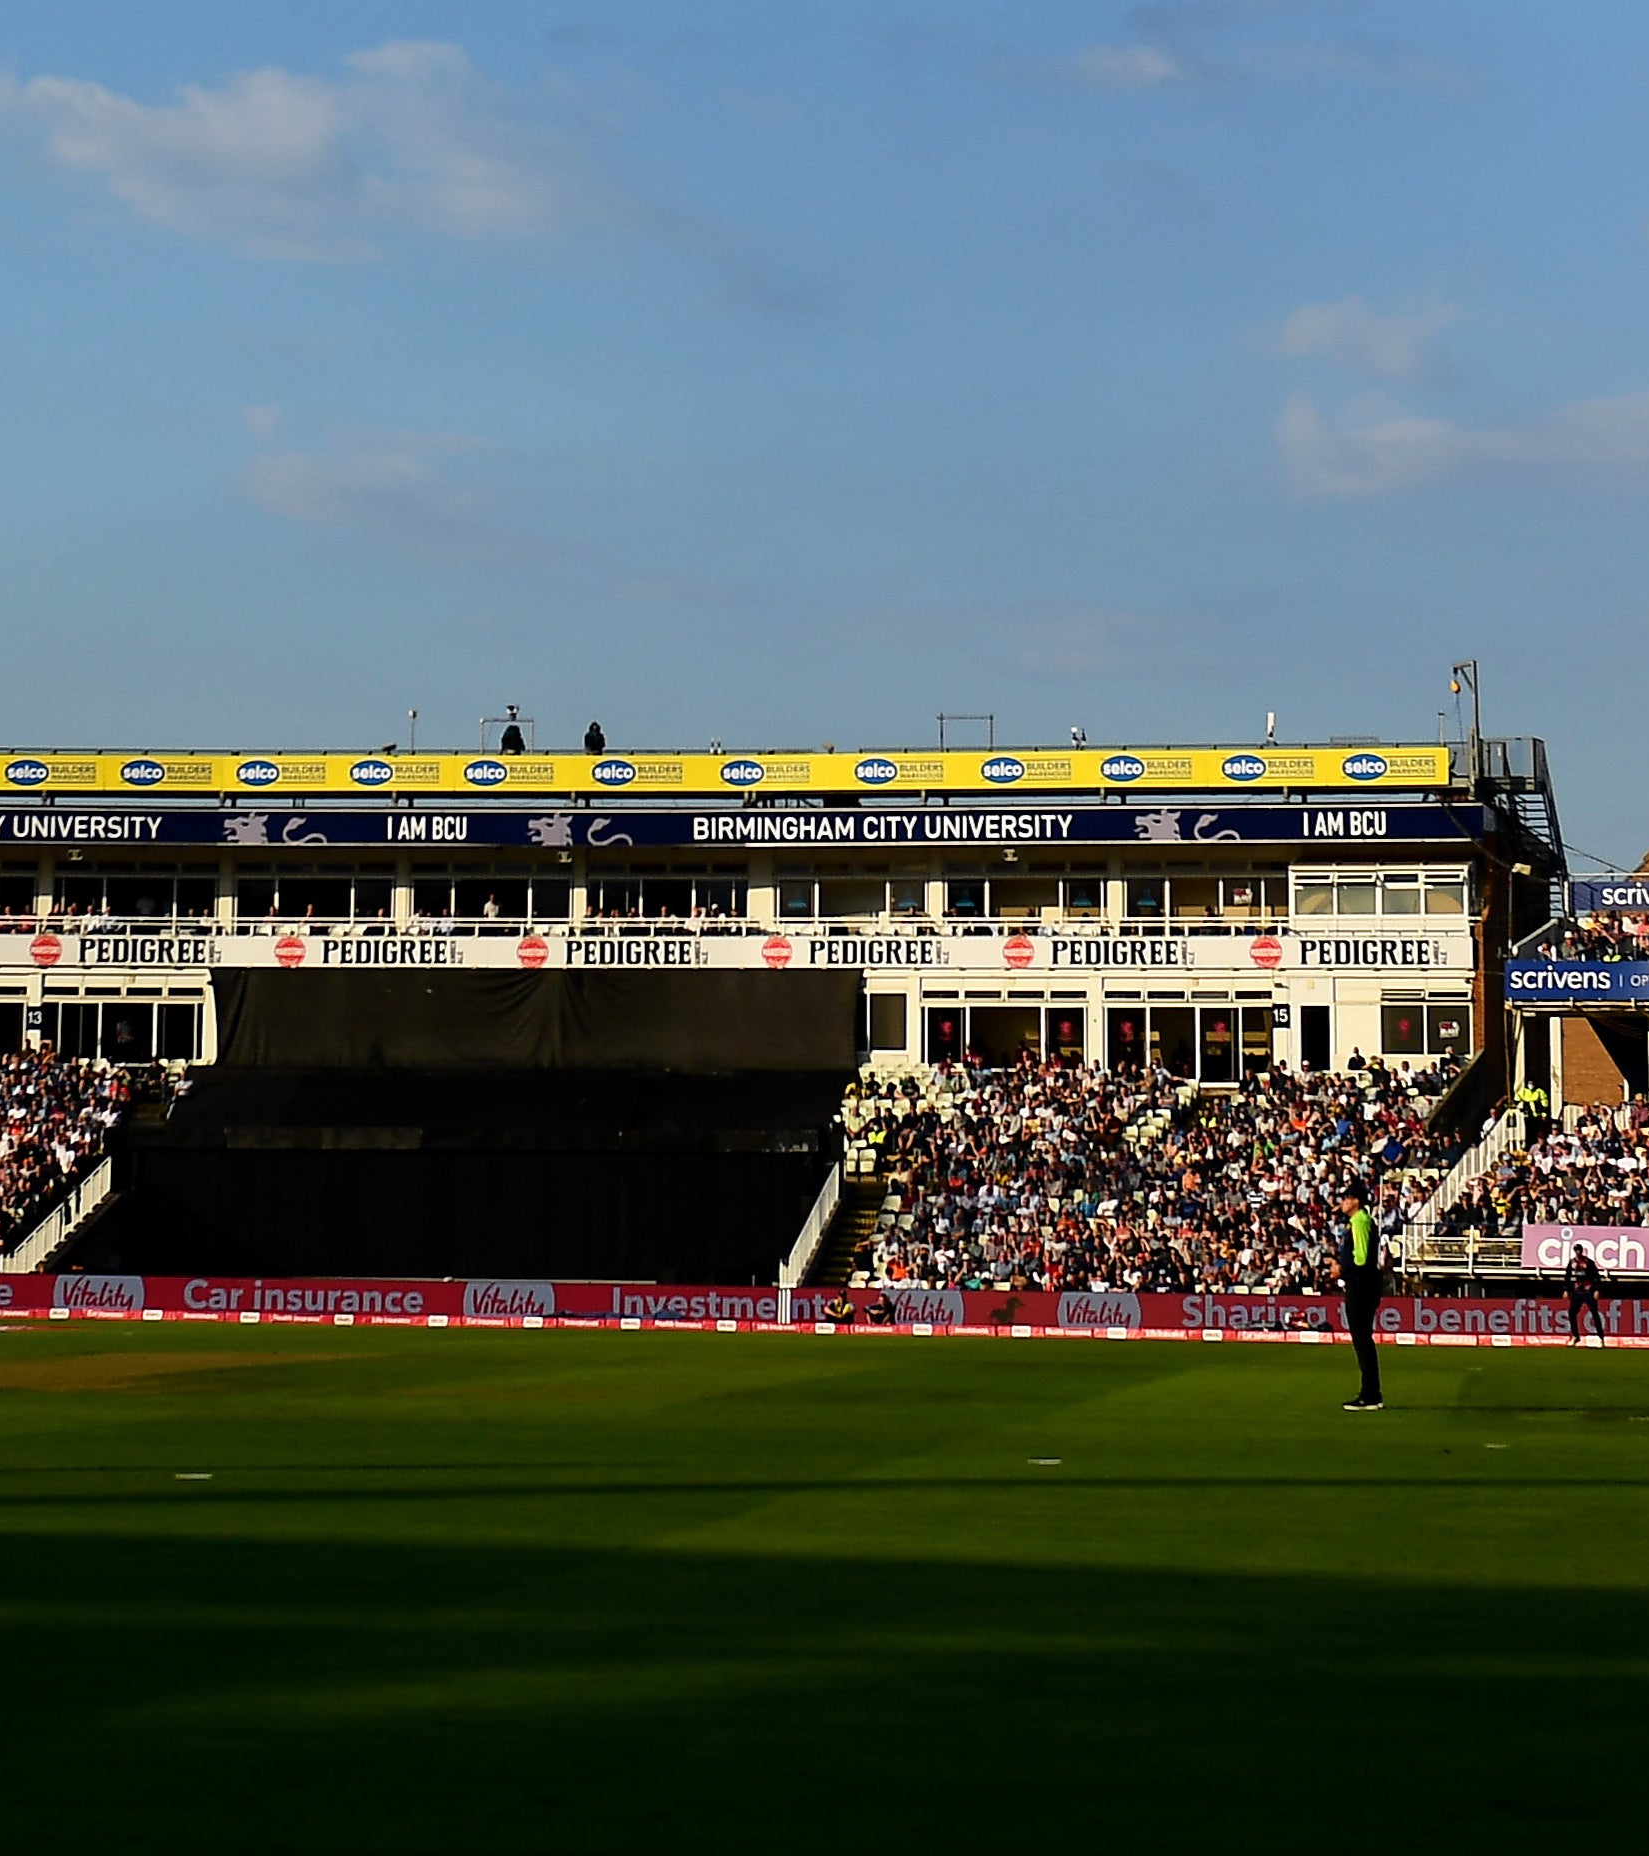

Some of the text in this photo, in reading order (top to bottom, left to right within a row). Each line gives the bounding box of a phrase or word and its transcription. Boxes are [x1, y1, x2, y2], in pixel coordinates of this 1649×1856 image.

[7, 764, 47, 779] selco
[122, 766, 163, 780] selco
[239, 766, 279, 780] selco
[351, 766, 392, 780] selco
[465, 766, 506, 780] selco
[593, 766, 635, 780] selco
[722, 765, 763, 780] selco
[856, 764, 897, 779] selco
[983, 762, 1024, 777] selco
[1102, 760, 1143, 776] selco
[1223, 760, 1265, 775] selco
[1344, 759, 1386, 774] selco
[12, 815, 163, 838] UNIVERSITY
[387, 816, 467, 840] I AM BCU
[693, 814, 1073, 840] BIRMINGHAM CITY UNIVERSITY
[1303, 810, 1387, 836] I AM BCU
[79, 938, 205, 964] PEDIGREE
[323, 940, 447, 964] PEDIGREE
[565, 940, 692, 964] PEDIGREE
[809, 940, 933, 964] PEDIGREE
[1052, 940, 1179, 964] PEDIGREE
[1301, 940, 1430, 964] PEDIGREE
[1510, 966, 1611, 989] scrivens
[29, 1011, 42, 1024] 13
[1273, 1008, 1288, 1022] 15
[1537, 1227, 1645, 1268] cinch
[61, 1275, 135, 1310] Vitality
[184, 1278, 424, 1314] Car insurance
[471, 1282, 546, 1316] Vitality
[613, 1287, 833, 1322] Investment
[1067, 1298, 1131, 1329] Vitality
[1414, 1298, 1571, 1334] benefits
